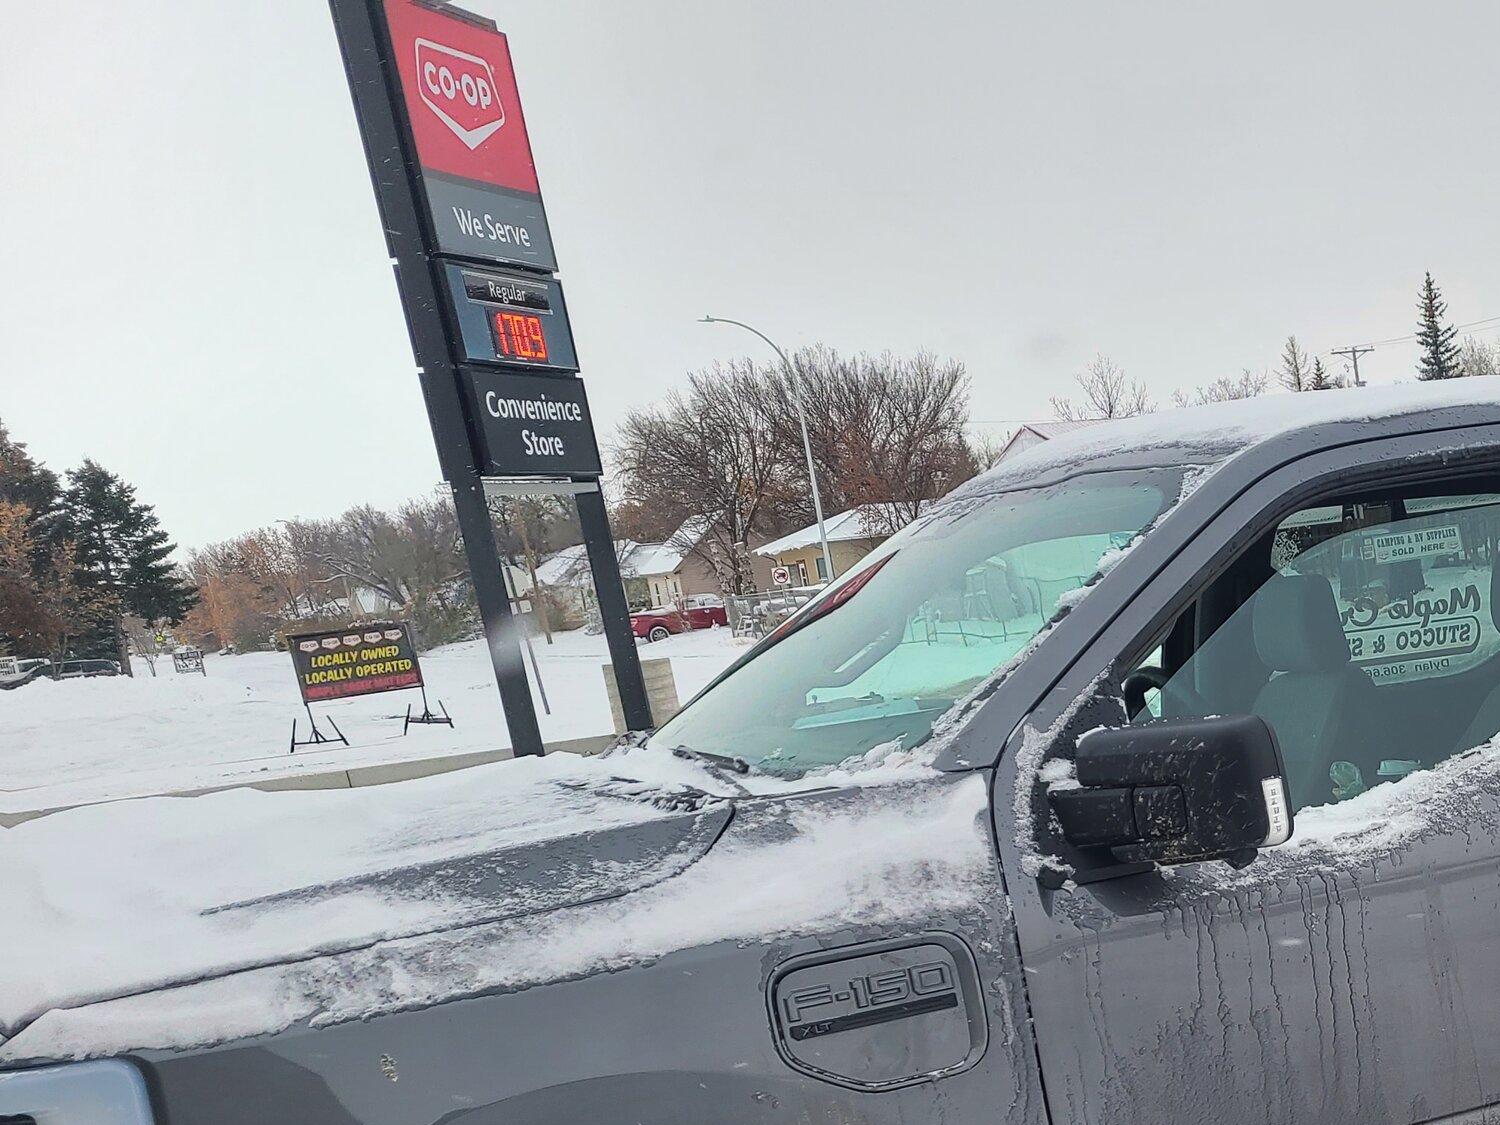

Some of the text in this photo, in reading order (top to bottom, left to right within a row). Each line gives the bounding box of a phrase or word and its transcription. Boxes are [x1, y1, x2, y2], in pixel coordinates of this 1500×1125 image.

[424, 61, 492, 109] CO-OP
[452, 206, 531, 248] We Serve
[487, 280, 526, 304] Regular
[496, 312, 547, 360] 170.9
[485, 390, 582, 422] Convenience
[521, 430, 565, 456] Store
[1376, 535, 1405, 548] CAMPING
[1414, 532, 1424, 543] RV
[1426, 527, 1457, 541] SUPPLIES
[1391, 542, 1445, 557] SOLD HERE
[311, 645, 399, 668] LOCALLY OWNED
[305, 667, 353, 685] LOCALLY
[356, 658, 412, 677] OPERATED
[783, 961, 954, 1023] F-150
[802, 1022, 833, 1037] XLT
